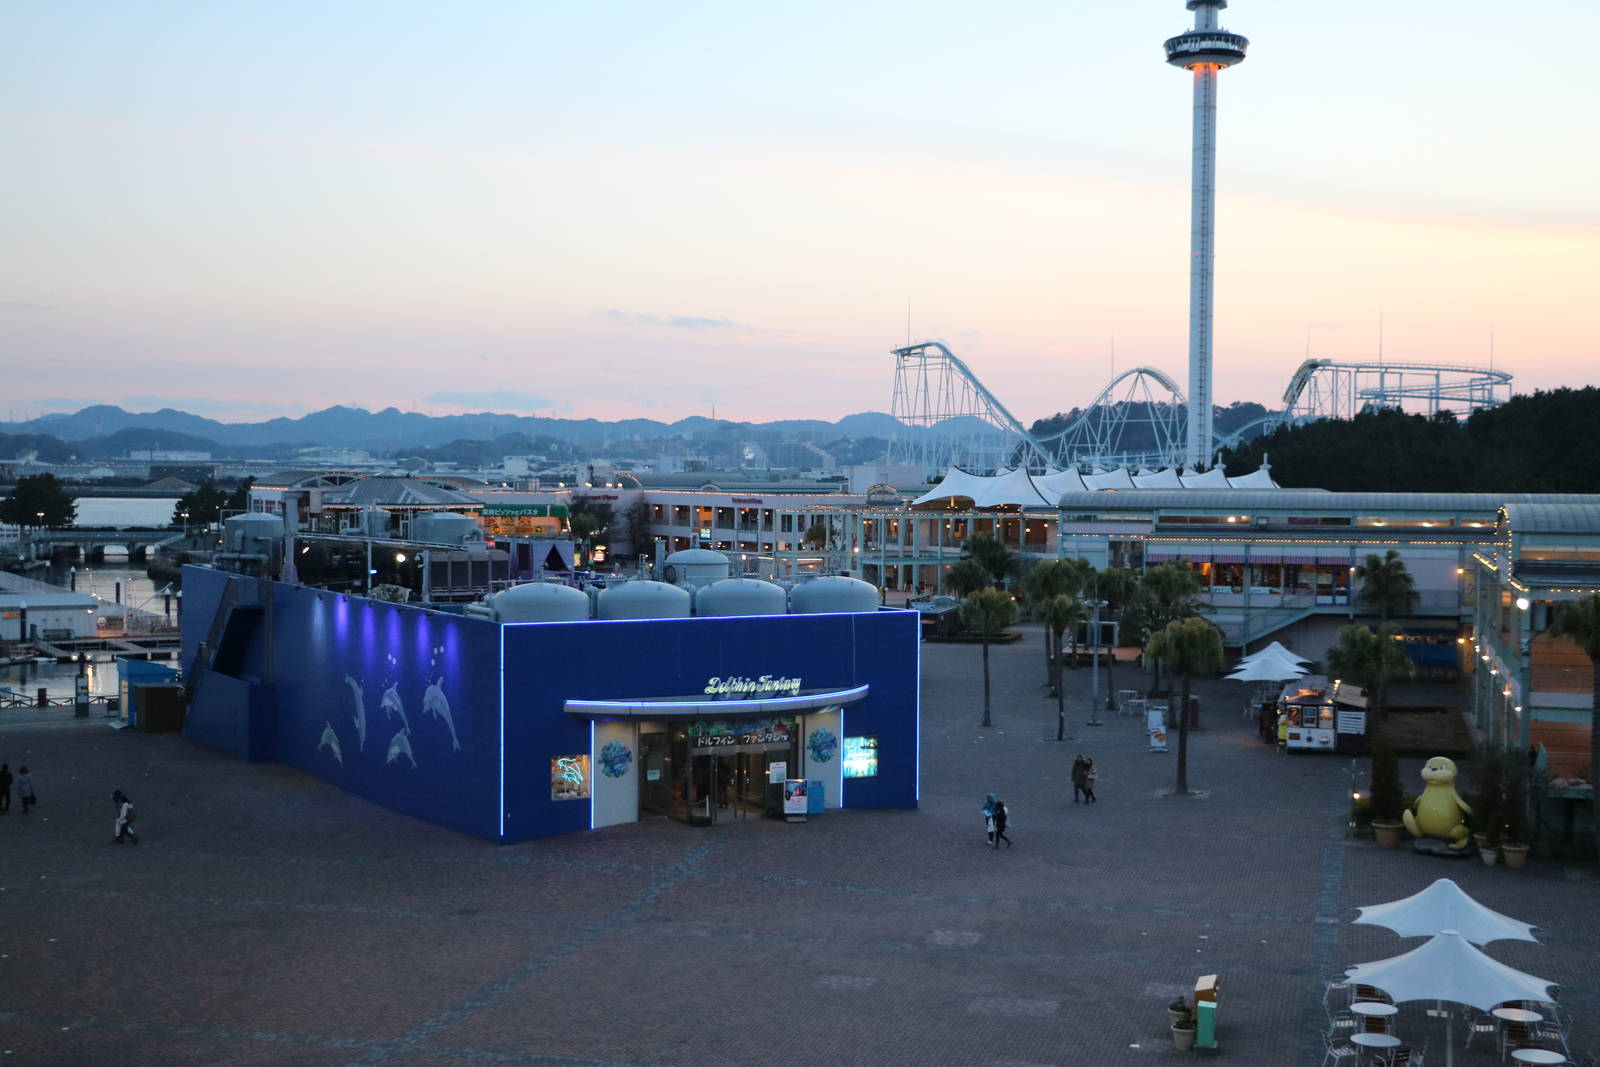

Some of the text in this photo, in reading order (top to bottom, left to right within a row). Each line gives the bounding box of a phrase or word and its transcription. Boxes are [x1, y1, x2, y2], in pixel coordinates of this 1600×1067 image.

[481, 508, 539, 516] ピッツァとパスタ
[704, 675, 802, 696] Dolphin Fantasy
[698, 736, 735, 747] ドルフィン
